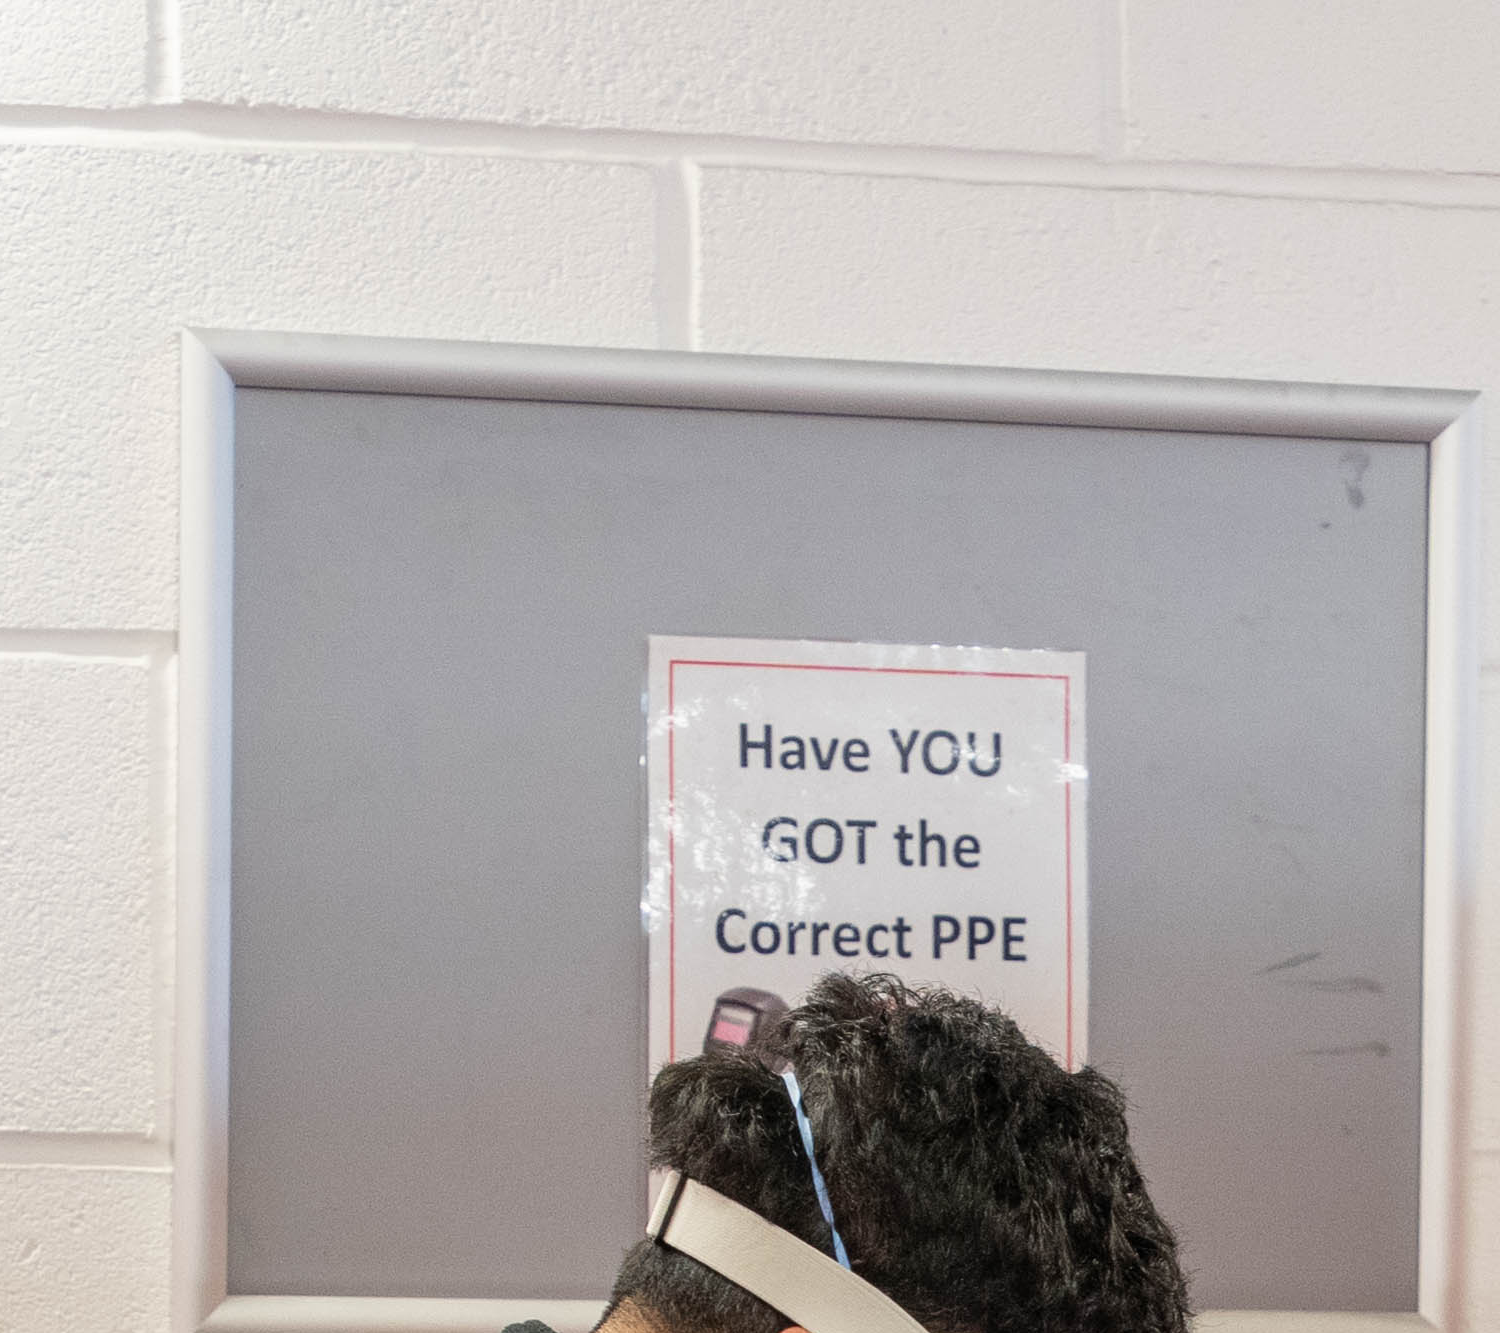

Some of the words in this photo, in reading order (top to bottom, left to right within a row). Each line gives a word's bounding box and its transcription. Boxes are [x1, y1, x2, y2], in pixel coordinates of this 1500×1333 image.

[739, 722, 871, 772] Have
[889, 728, 1002, 779] YOU
[761, 815, 878, 866] GOT
[893, 818, 982, 870] the
[714, 907, 913, 960] Correct
[931, 914, 1028, 963] PPE
